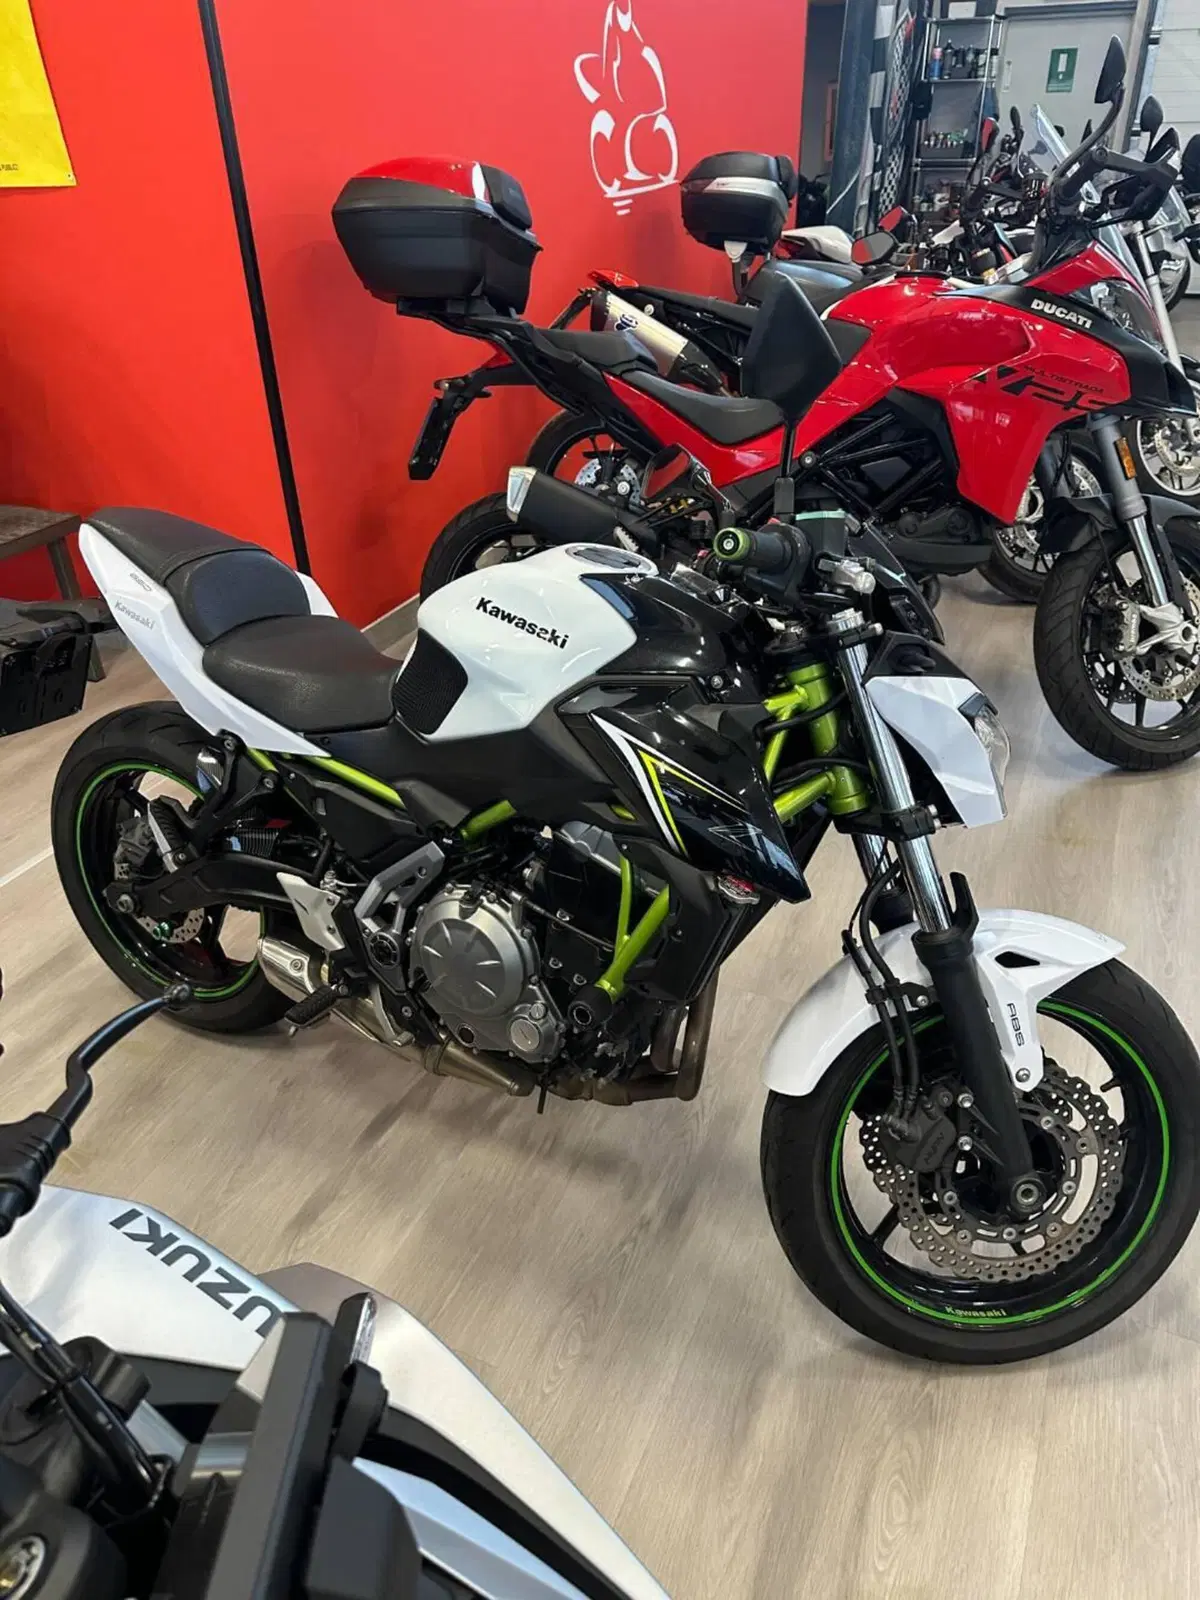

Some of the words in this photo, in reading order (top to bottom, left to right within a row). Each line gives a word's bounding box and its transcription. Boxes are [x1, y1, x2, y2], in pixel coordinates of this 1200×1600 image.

[1030, 298, 1093, 329] DUCATI
[114, 600, 155, 631] Kawasaki
[476, 597, 569, 649] Kawasaki
[1006, 1002, 1026, 1047] ABS
[108, 1207, 284, 1339] UZUKI
[944, 1306, 1007, 1317] Kawasaki
